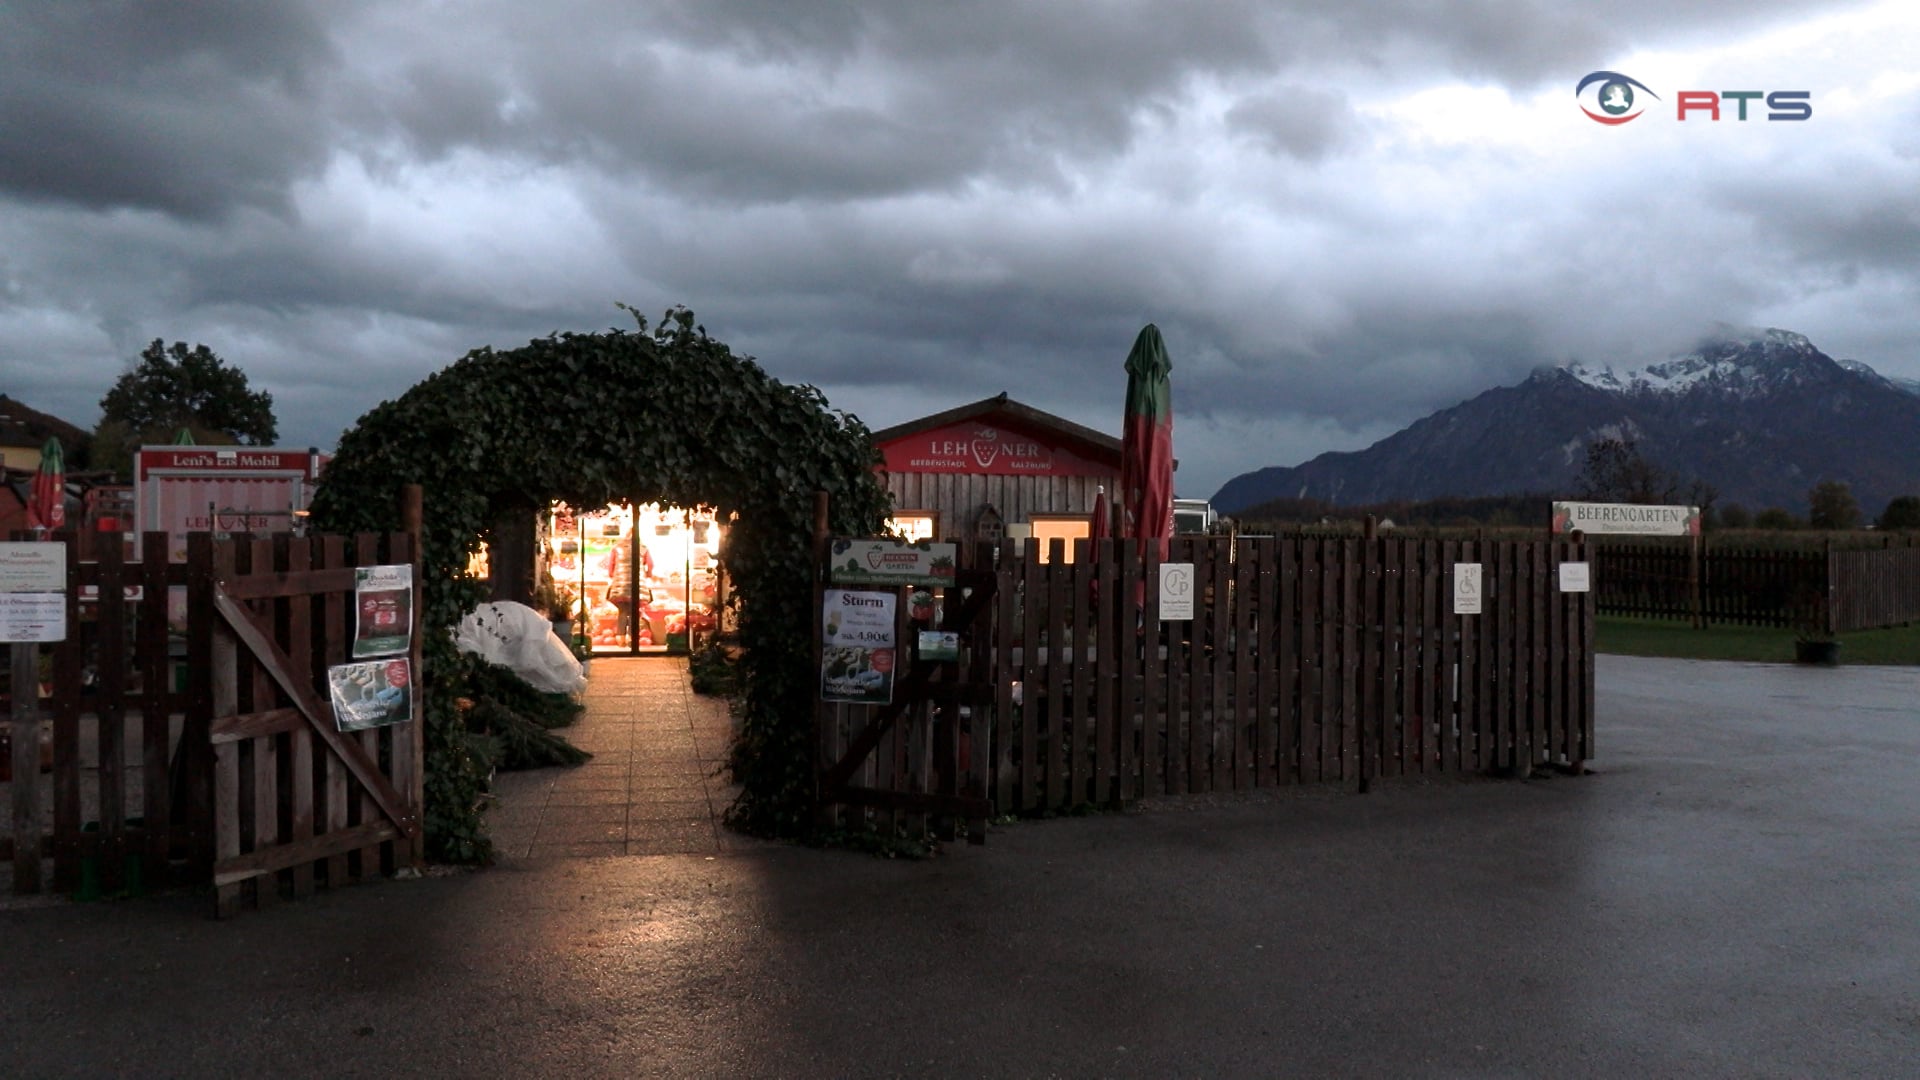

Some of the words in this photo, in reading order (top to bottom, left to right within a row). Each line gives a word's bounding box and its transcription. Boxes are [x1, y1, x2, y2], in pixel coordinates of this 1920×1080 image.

[173, 454, 215, 467] Leni's
[216, 456, 238, 467] Eis
[240, 454, 280, 467] Mobil
[1577, 506, 1679, 522] BEERENGARTEN
[842, 592, 884, 608] Sturm
